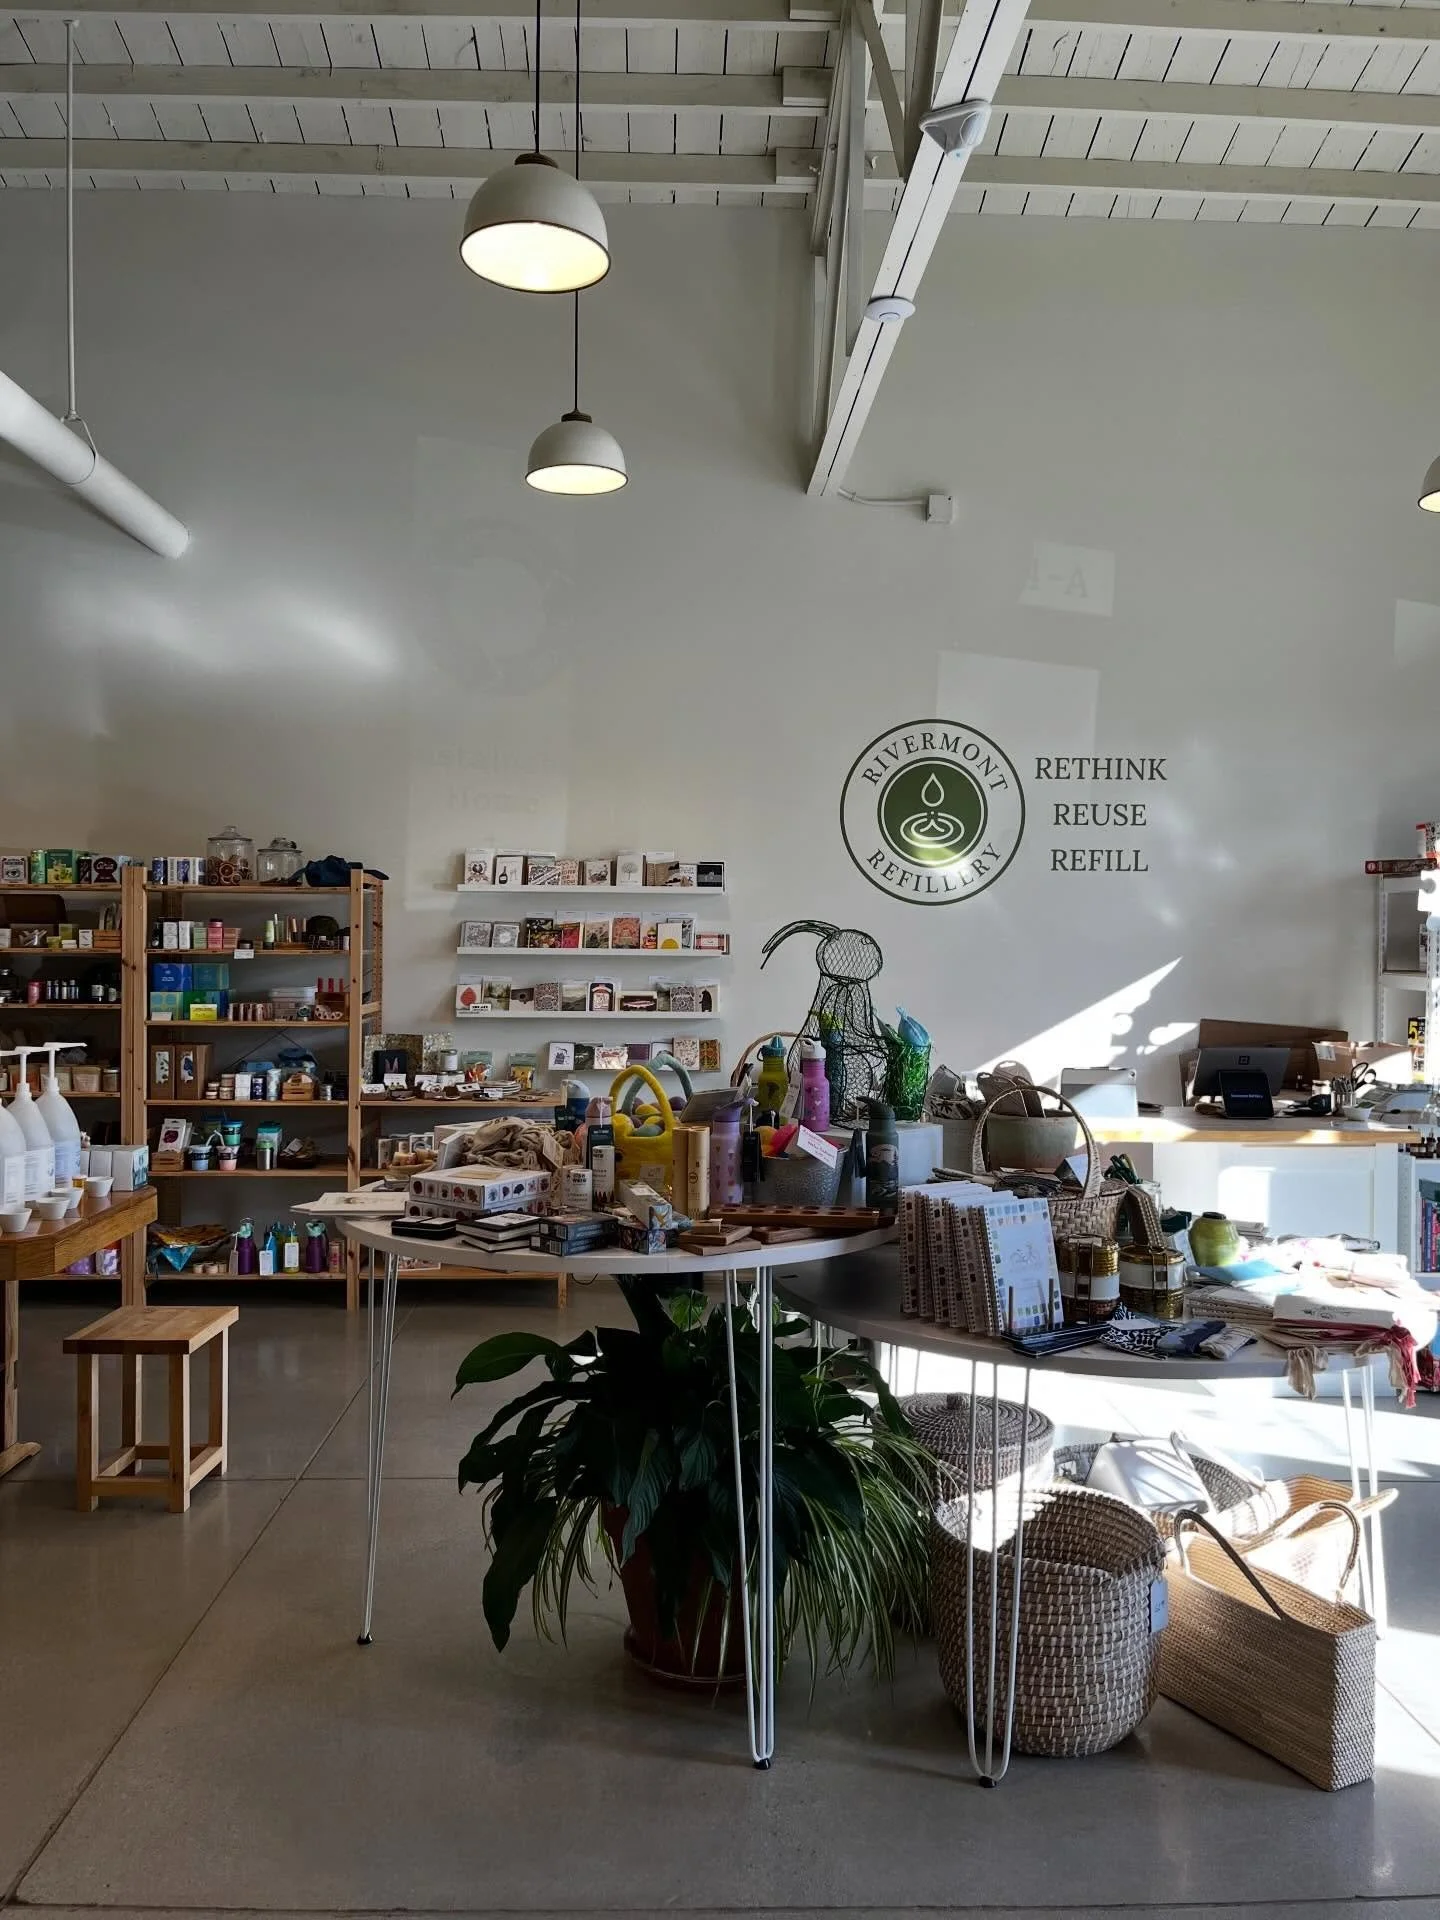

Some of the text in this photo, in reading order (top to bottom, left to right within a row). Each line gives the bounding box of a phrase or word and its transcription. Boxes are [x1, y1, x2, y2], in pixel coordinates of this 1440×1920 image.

[861, 731, 1009, 792] RIVERMONT
[1035, 756, 1167, 781] RETHINK
[1053, 803, 1147, 827] REUSE
[866, 842, 1002, 894] REFILLERY
[1050, 849, 1149, 873] REFILL
